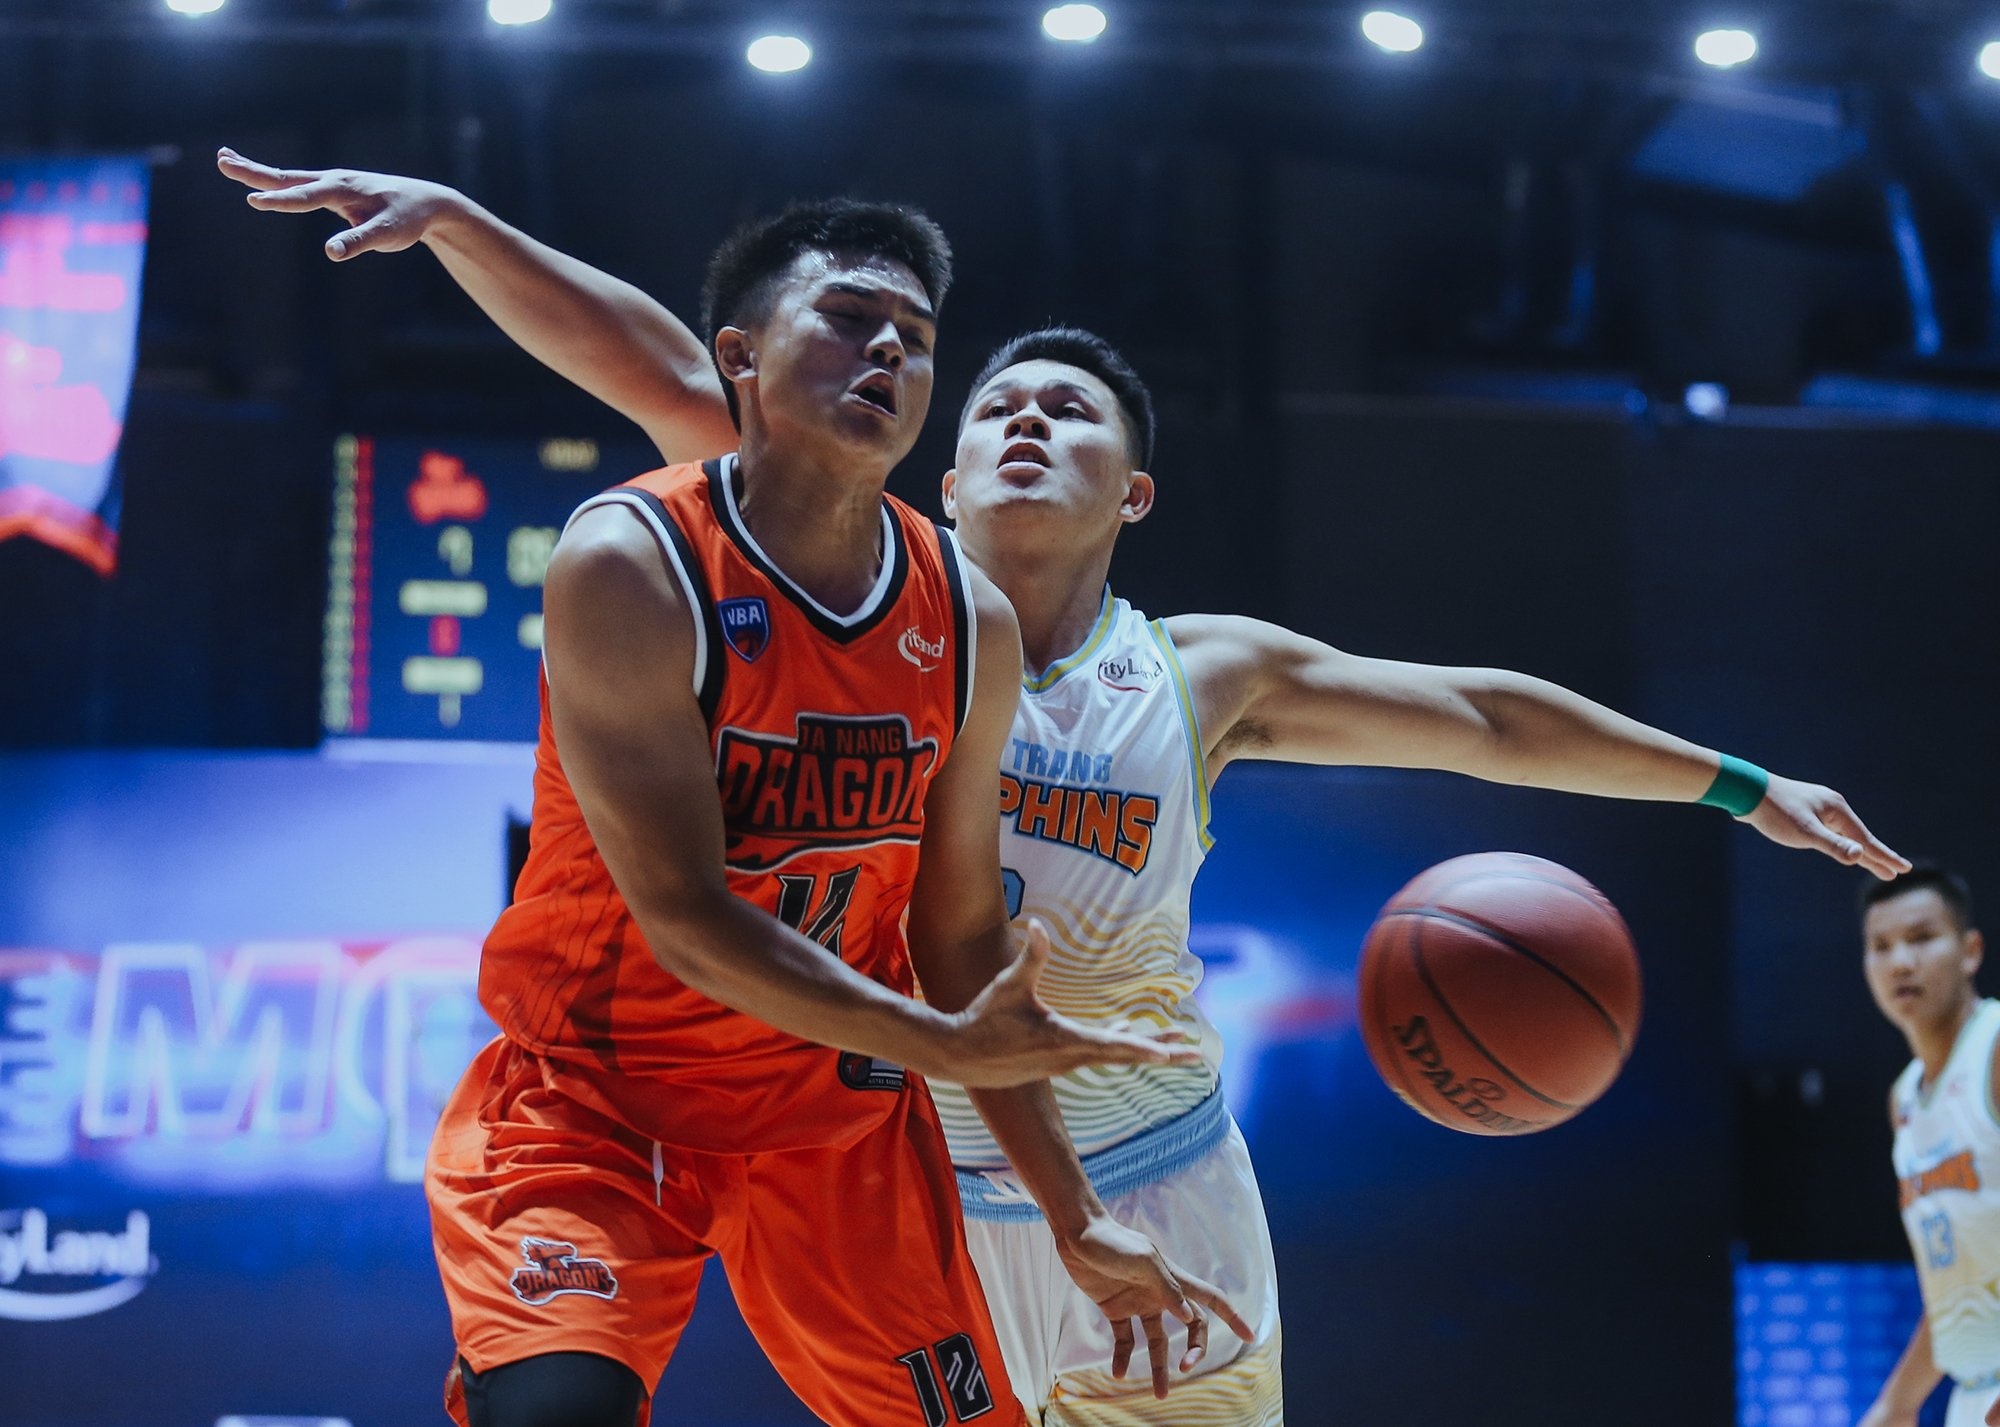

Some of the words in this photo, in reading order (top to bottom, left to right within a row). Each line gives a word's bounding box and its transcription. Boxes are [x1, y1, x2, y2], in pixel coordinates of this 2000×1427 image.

[727, 604, 761, 626] VBA
[836, 726, 901, 754] NANG
[1013, 738, 1113, 784] TRANG
[722, 738, 933, 828] DRAGON
[1000, 772, 1158, 876] PHINS
[519, 1267, 611, 1292] DRAGONS
